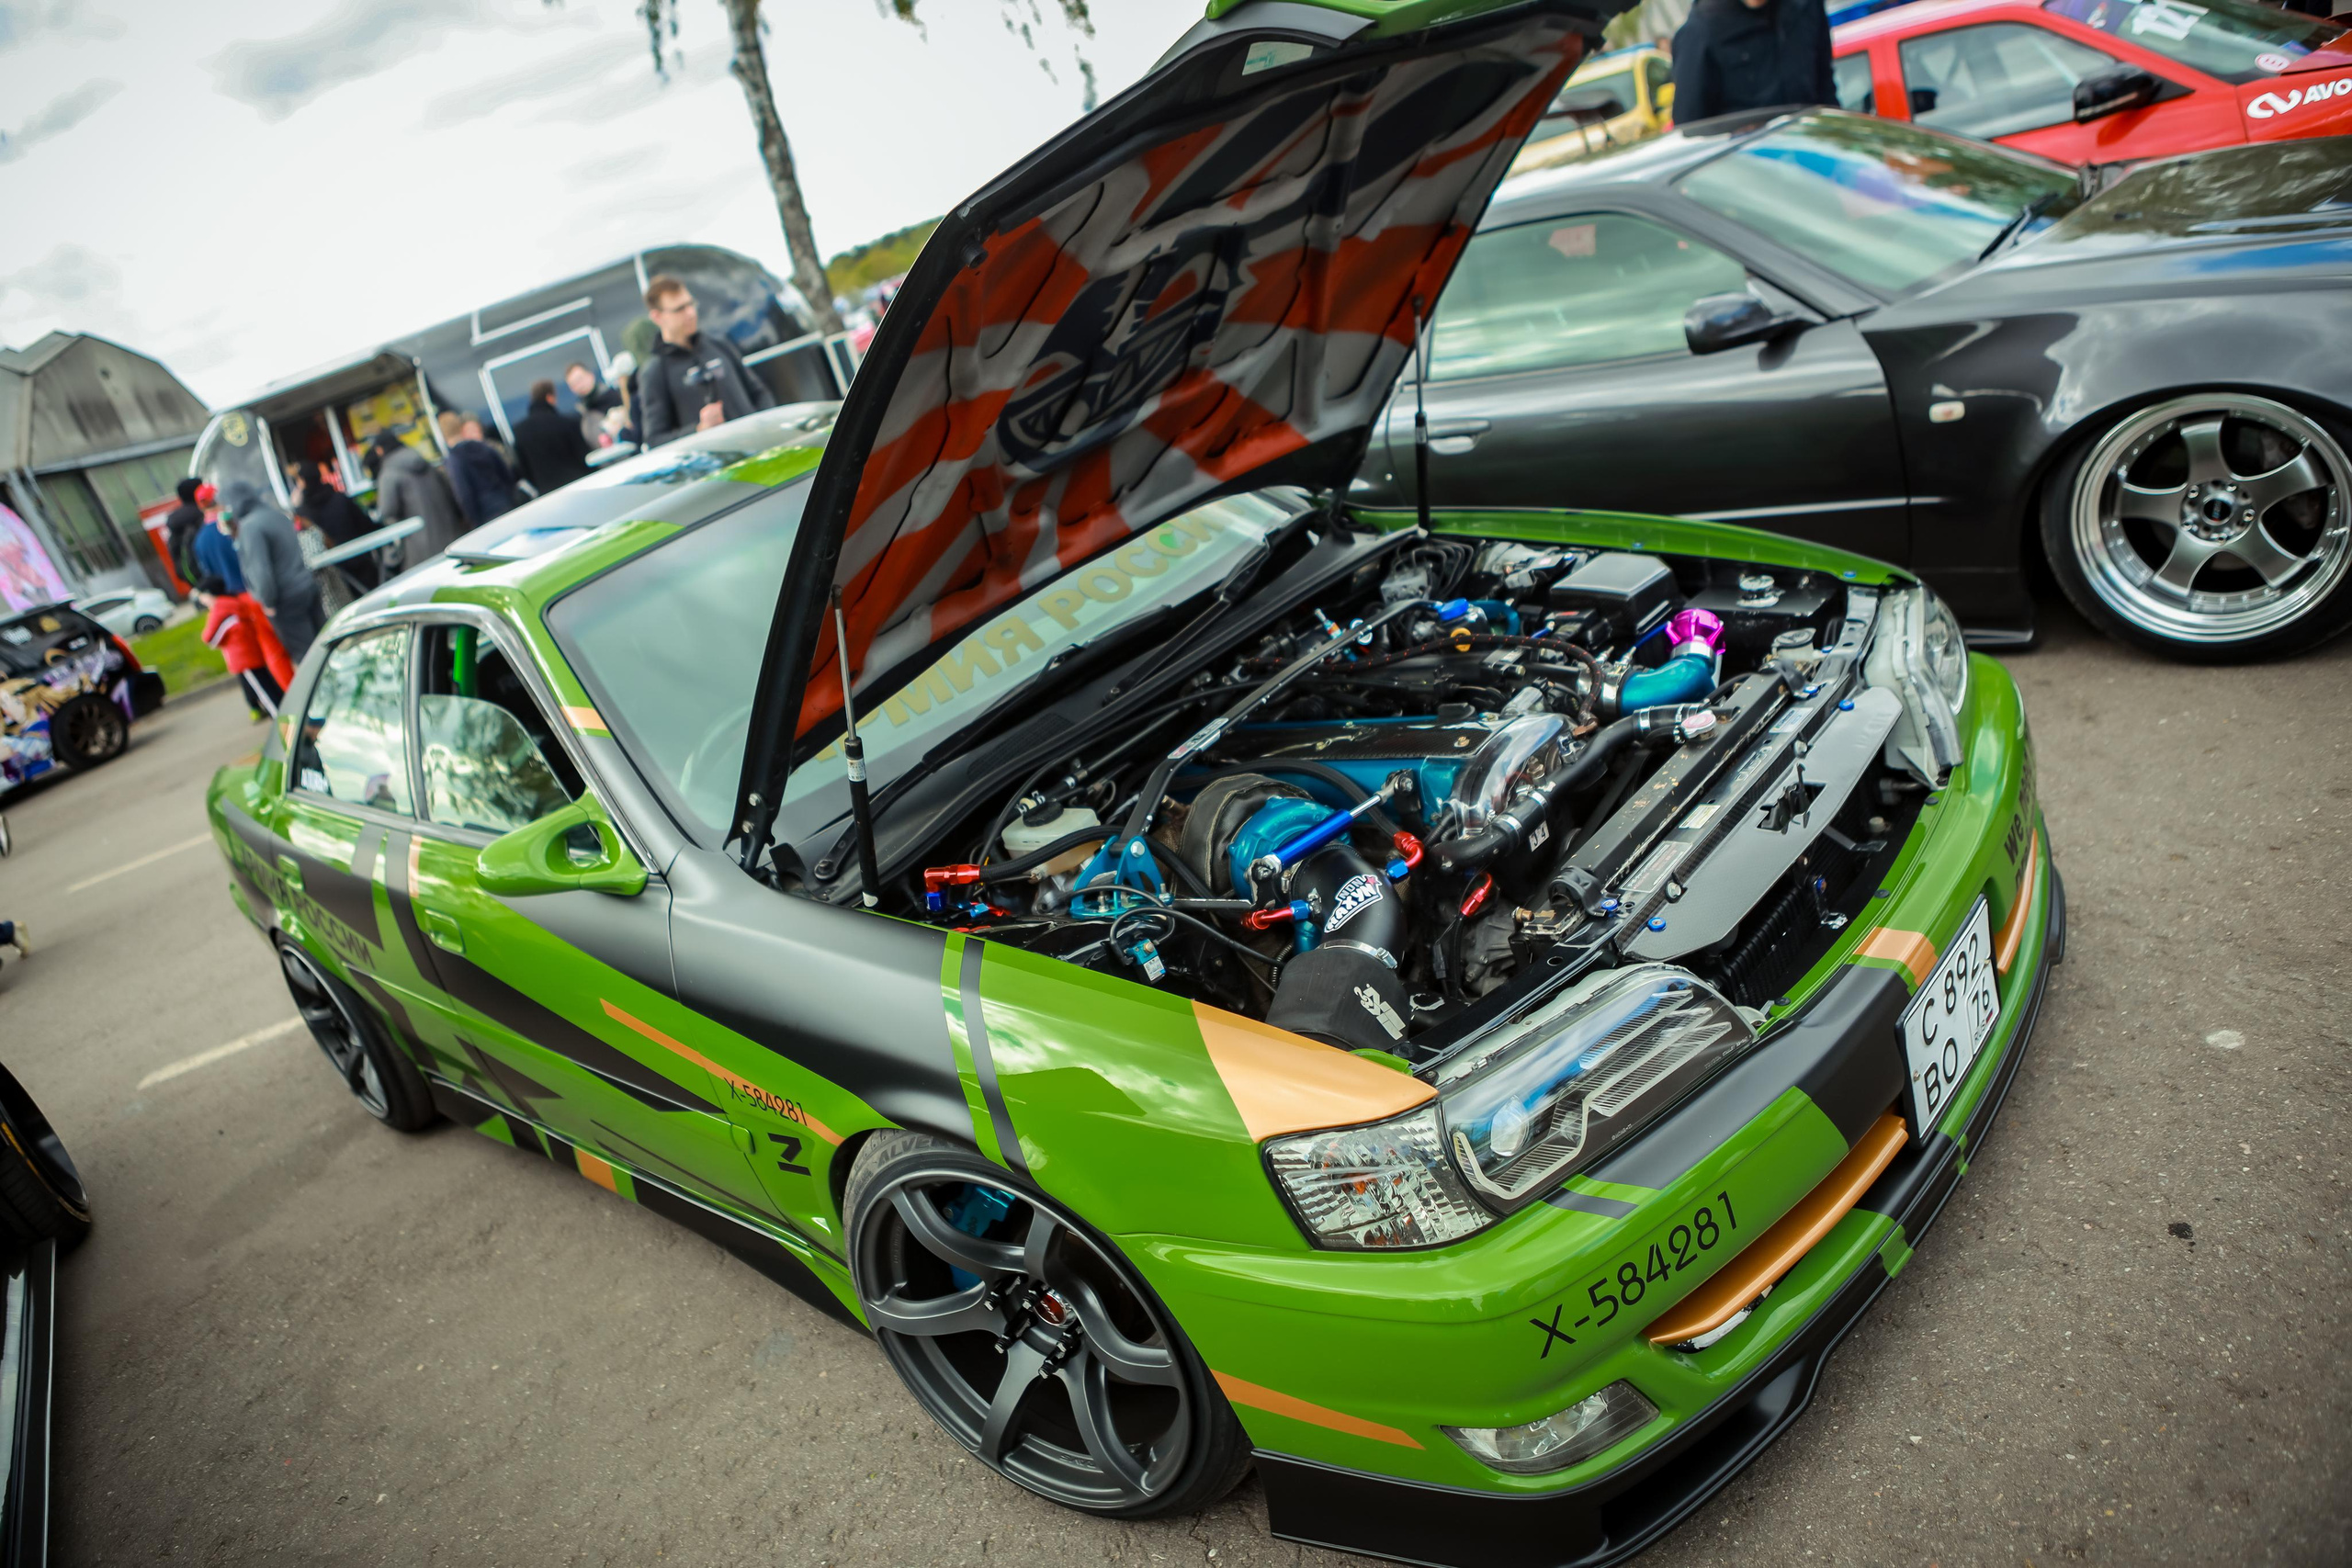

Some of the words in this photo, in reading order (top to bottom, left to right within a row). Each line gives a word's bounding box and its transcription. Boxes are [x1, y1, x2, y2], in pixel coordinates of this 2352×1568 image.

[1038, 504, 1246, 630] РОССИ
[1942, 932, 1979, 1015] 892
[1972, 976, 1991, 1027] 76
[724, 1077, 808, 1127] X-584281
[1529, 1190, 1737, 1360] X-584281
